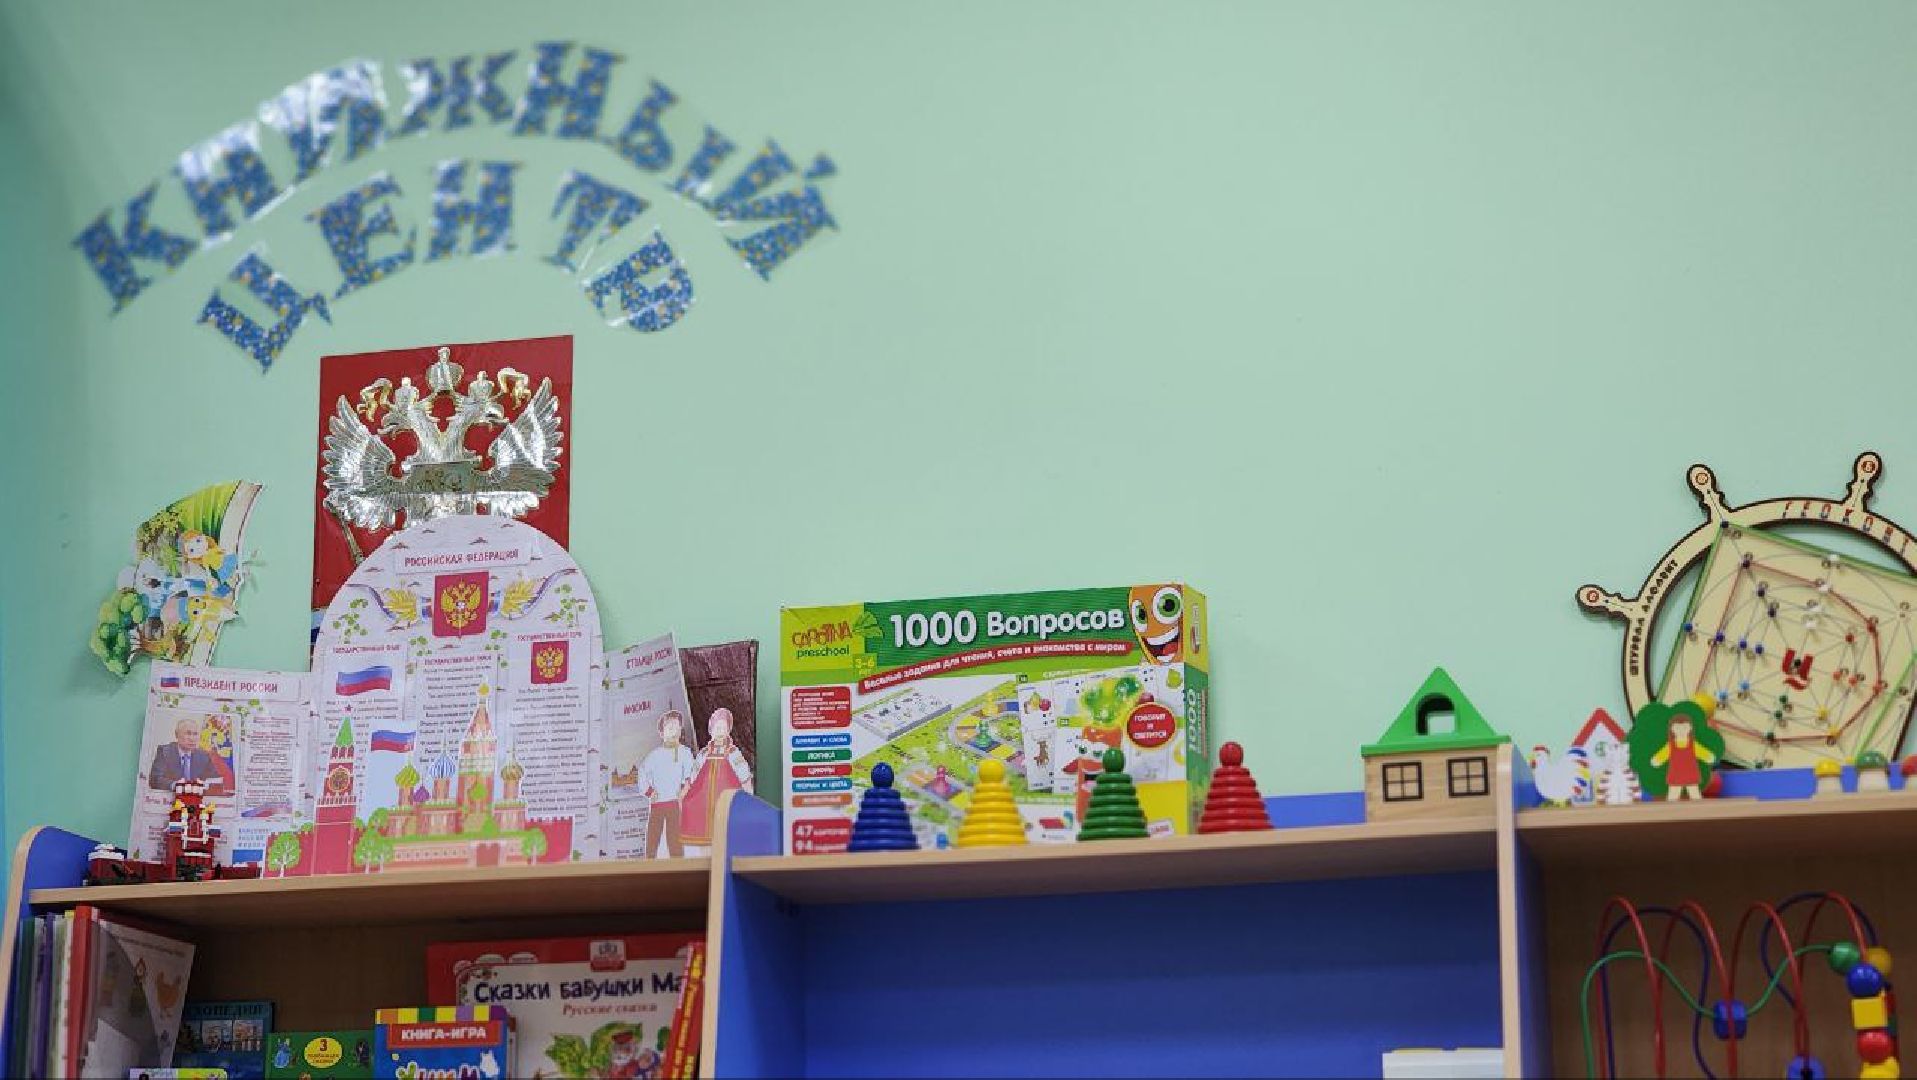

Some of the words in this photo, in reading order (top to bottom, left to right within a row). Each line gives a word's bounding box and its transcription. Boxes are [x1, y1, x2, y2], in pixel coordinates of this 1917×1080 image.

[70, 40, 842, 316] КНИЖНЫЙ
[198, 160, 696, 373] ЦЕНТР
[890, 610, 977, 647] 1000
[987, 609, 1125, 640] Вопросов
[797, 645, 850, 660] preschool
[942, 657, 960, 670] для
[1024, 646, 1032, 654] и
[1033, 643, 1086, 655] знакомства
[183, 676, 237, 693] ПРЕЗИДЕНТ
[240, 682, 278, 693] РОССИИ
[474, 981, 550, 1003] Сказки
[563, 1004, 611, 1018] Русские
[616, 1003, 658, 1014] сказки
[401, 1027, 486, 1041] КНИГА-ИГРА
[320, 1038, 328, 1052] 3
